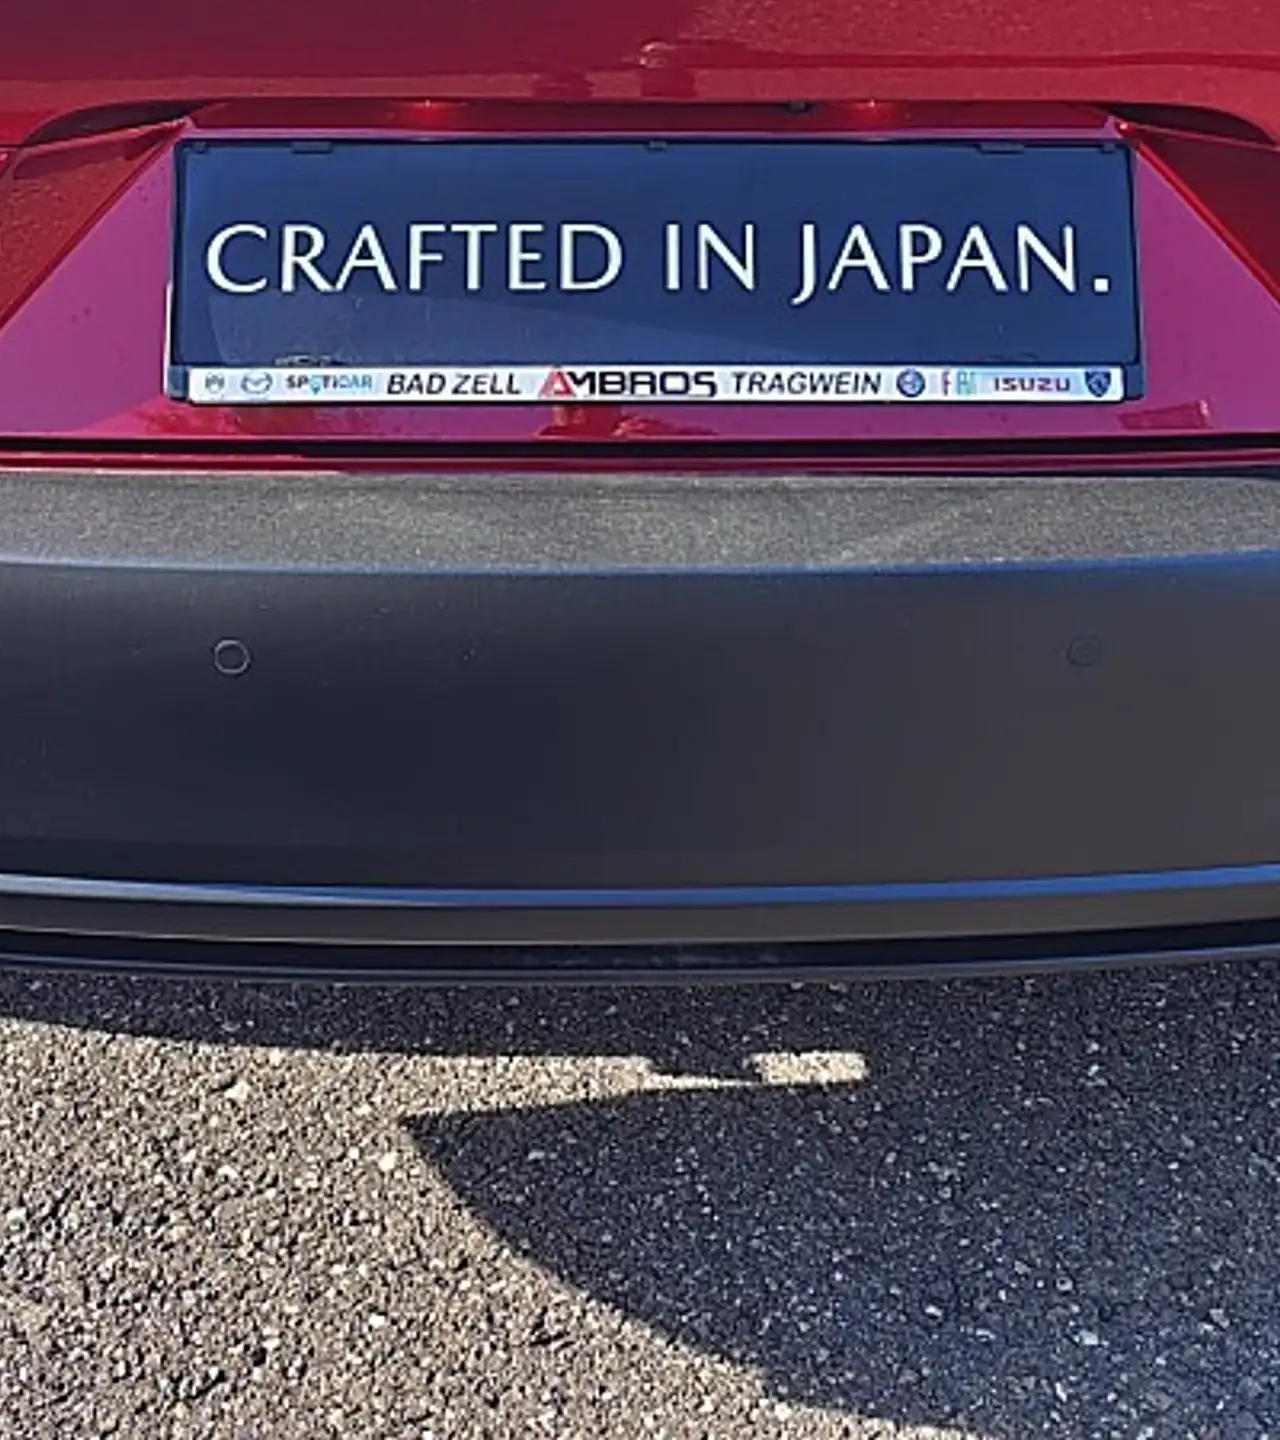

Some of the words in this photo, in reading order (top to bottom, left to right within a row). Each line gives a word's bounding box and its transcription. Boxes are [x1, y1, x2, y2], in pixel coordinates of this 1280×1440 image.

[205, 222, 625, 294] CRAFTED
[664, 223, 758, 293] IN
[791, 223, 1112, 306] JAPAN.
[387, 372, 447, 396] BAD
[451, 372, 522, 396] ZELL
[537, 366, 718, 398] AMBROS
[732, 370, 883, 396] TRAGWEIN
[994, 376, 1072, 392] ISUZU
